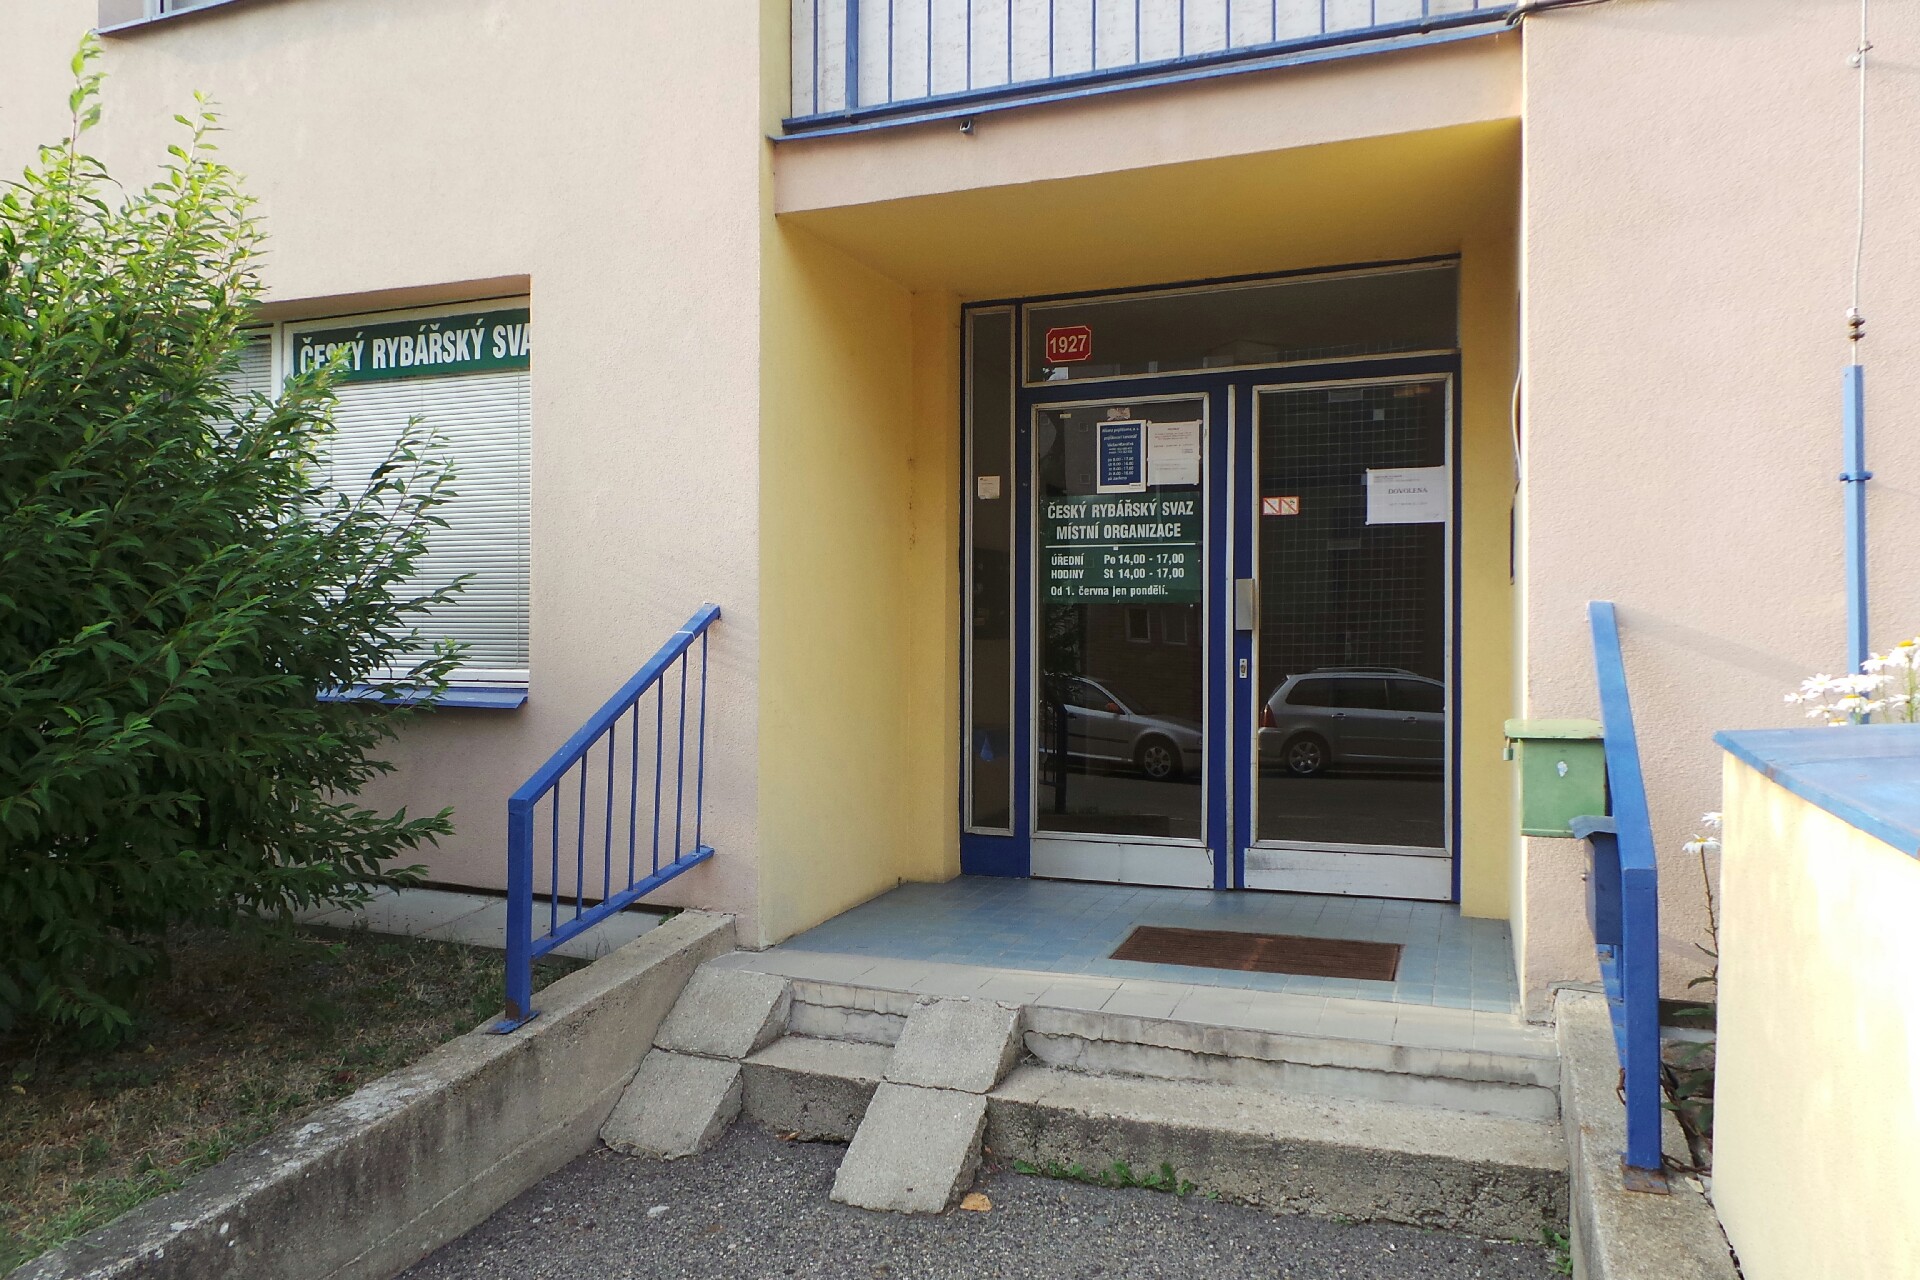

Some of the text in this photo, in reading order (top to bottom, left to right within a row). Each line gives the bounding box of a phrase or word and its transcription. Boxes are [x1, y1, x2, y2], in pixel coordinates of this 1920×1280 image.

[372, 318, 485, 369] RYBÁŘSKÝ
[1050, 334, 1087, 354] 1927
[1047, 498, 1194, 519] ČESKÝ RYBÁŘSKÝ SVAZ
[1056, 522, 1181, 540] MÍSTNÍ ORGANIZACE
[1051, 553, 1085, 566] ÚŘEDNÍ
[1103, 554, 1116, 565] Po
[1118, 553, 1146, 566] 14,00
[1156, 553, 1184, 566] 17,00
[1051, 569, 1084, 580] HODINY
[1103, 568, 1114, 579] St
[1118, 568, 1146, 580] 14,00
[1157, 568, 1185, 580] 17,00
[1050, 585, 1168, 598] Od 1. června jen pondělí.
